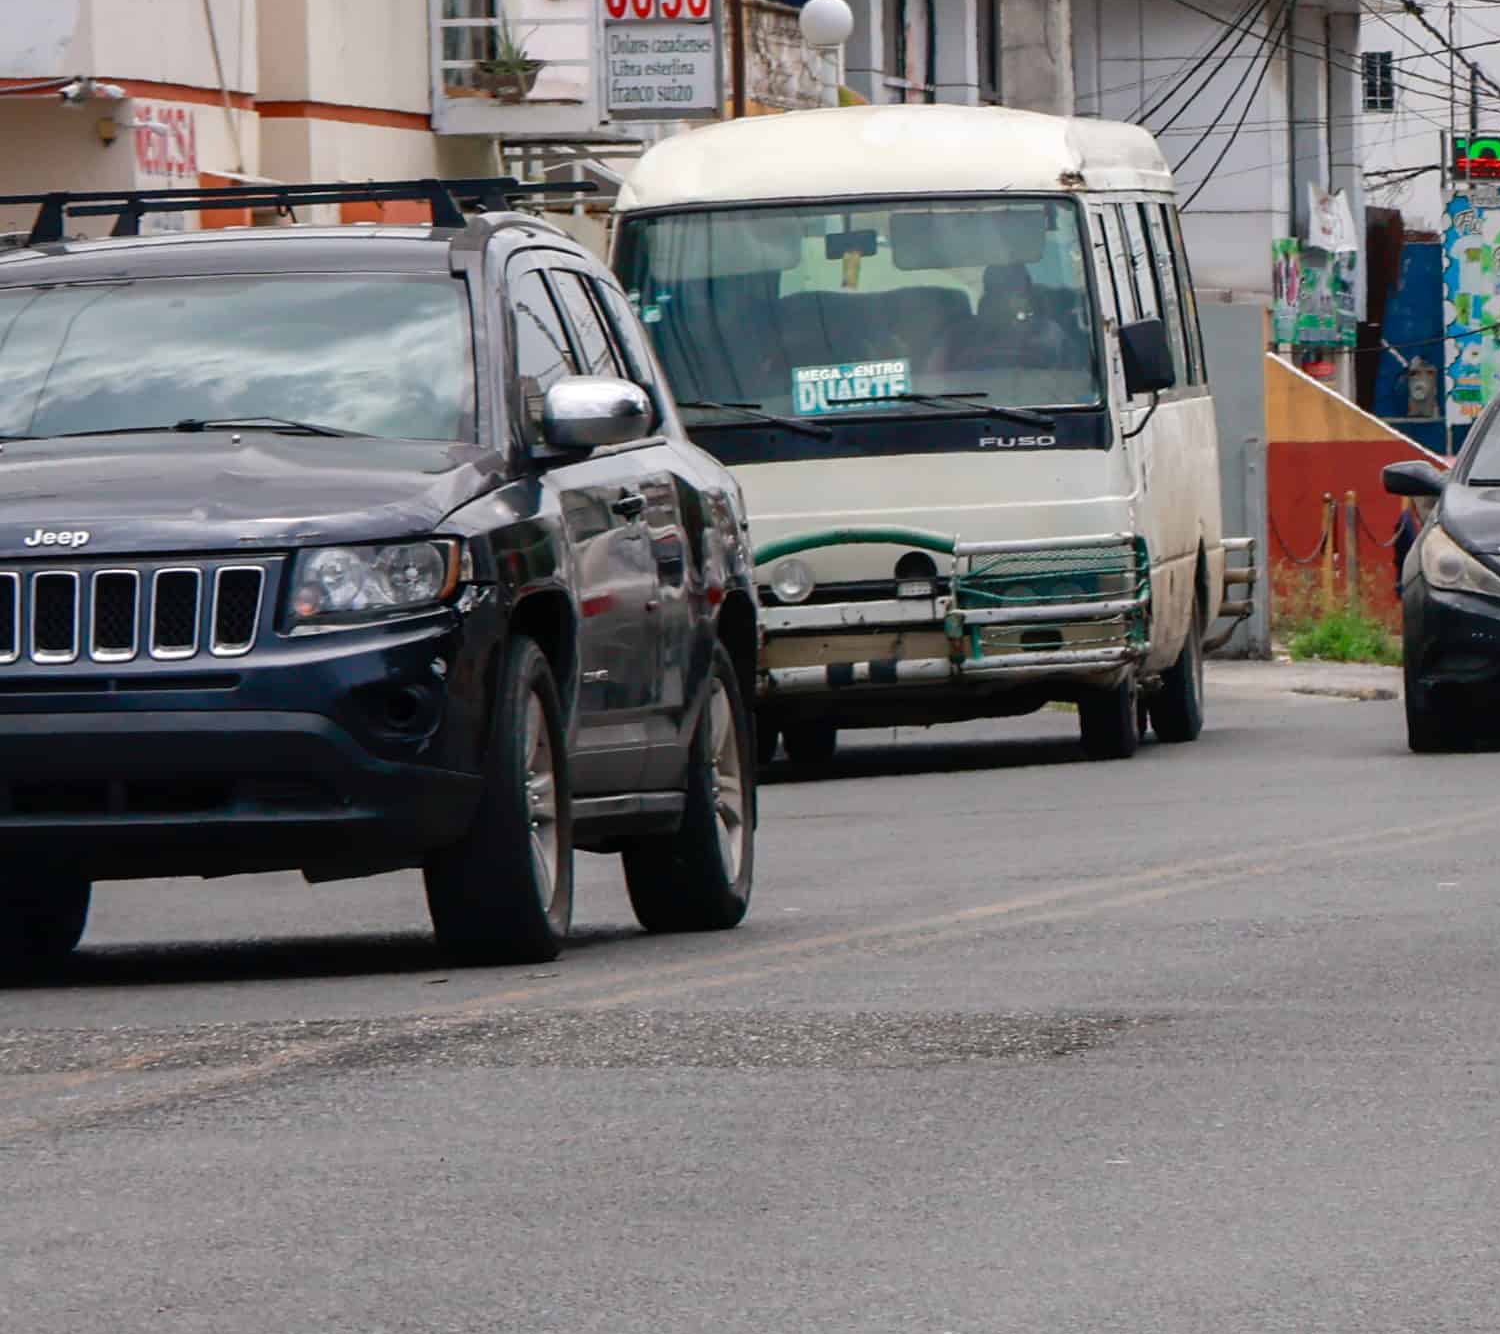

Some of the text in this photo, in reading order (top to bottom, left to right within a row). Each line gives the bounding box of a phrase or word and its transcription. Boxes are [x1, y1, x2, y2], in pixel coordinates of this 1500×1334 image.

[611, 59, 642, 76] Libra
[797, 367, 841, 382] MEGA
[798, 375, 905, 412] DUARTE
[978, 434, 1056, 448] FUSO
[24, 528, 92, 549] Jeep
